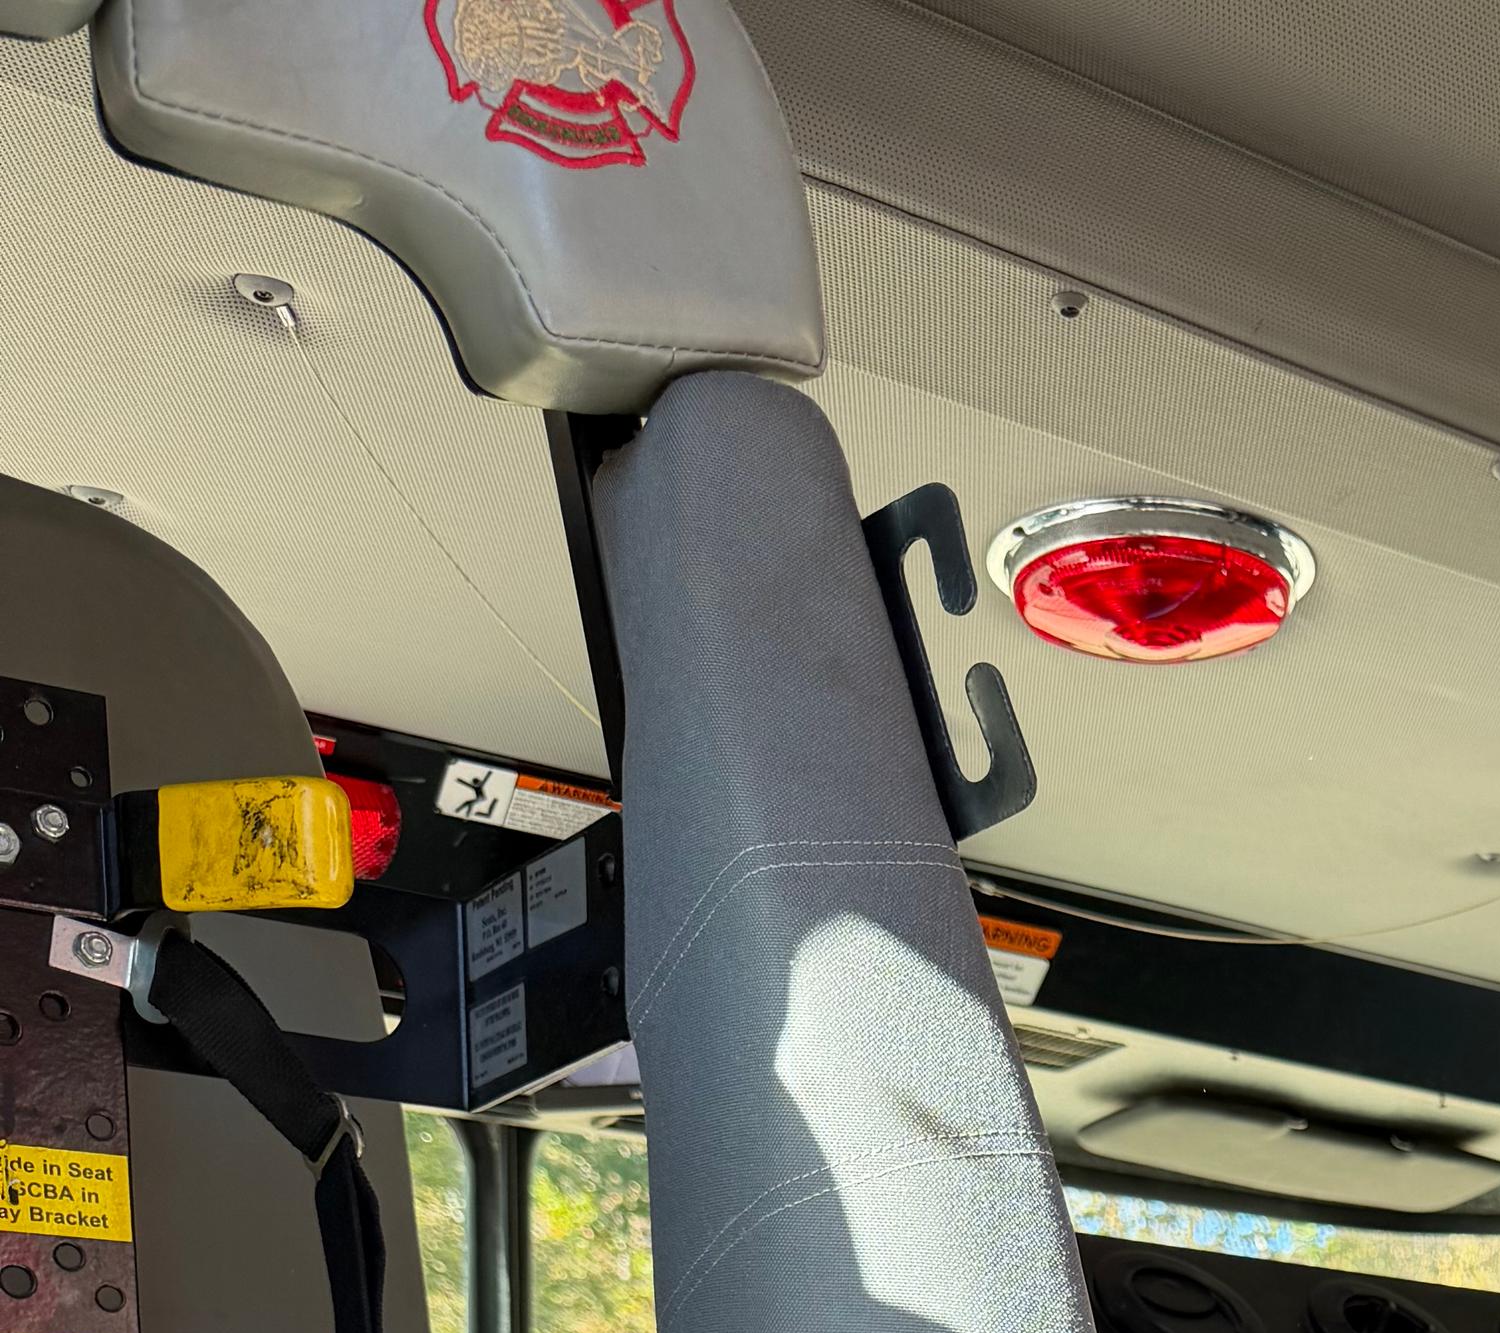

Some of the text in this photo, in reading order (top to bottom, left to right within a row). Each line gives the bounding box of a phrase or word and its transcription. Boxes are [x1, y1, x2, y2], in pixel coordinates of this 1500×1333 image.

[0, 1155, 113, 1181] ide in Seat
[81, 1187, 99, 1203] in
[29, 1206, 109, 1228] Bracket
